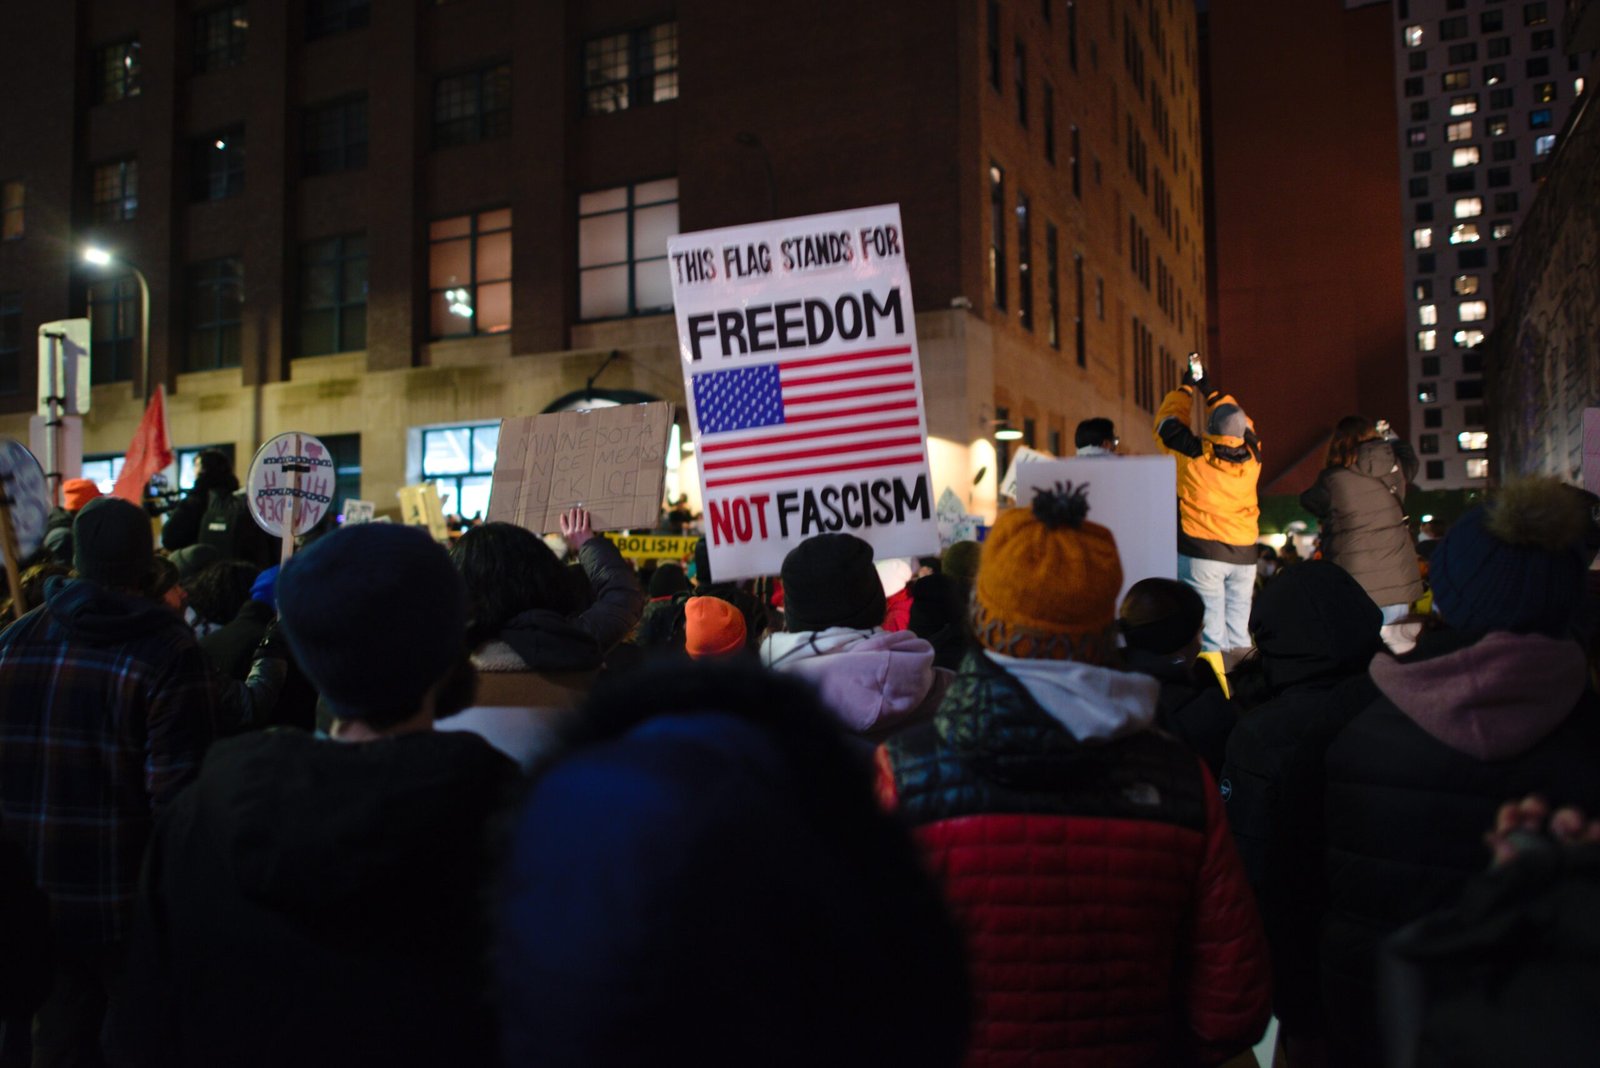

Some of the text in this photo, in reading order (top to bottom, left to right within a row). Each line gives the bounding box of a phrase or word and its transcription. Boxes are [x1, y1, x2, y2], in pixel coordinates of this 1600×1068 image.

[672, 224, 900, 284] THIS FLAG STANDS FOR
[687, 286, 905, 361] FREEDOM
[513, 425, 653, 461] MINNESOTA
[530, 443, 662, 478] NCE MEANS
[601, 470, 639, 498] ICE
[708, 473, 931, 547] NOT FASCISM
[618, 538, 679, 553] BOLISH
